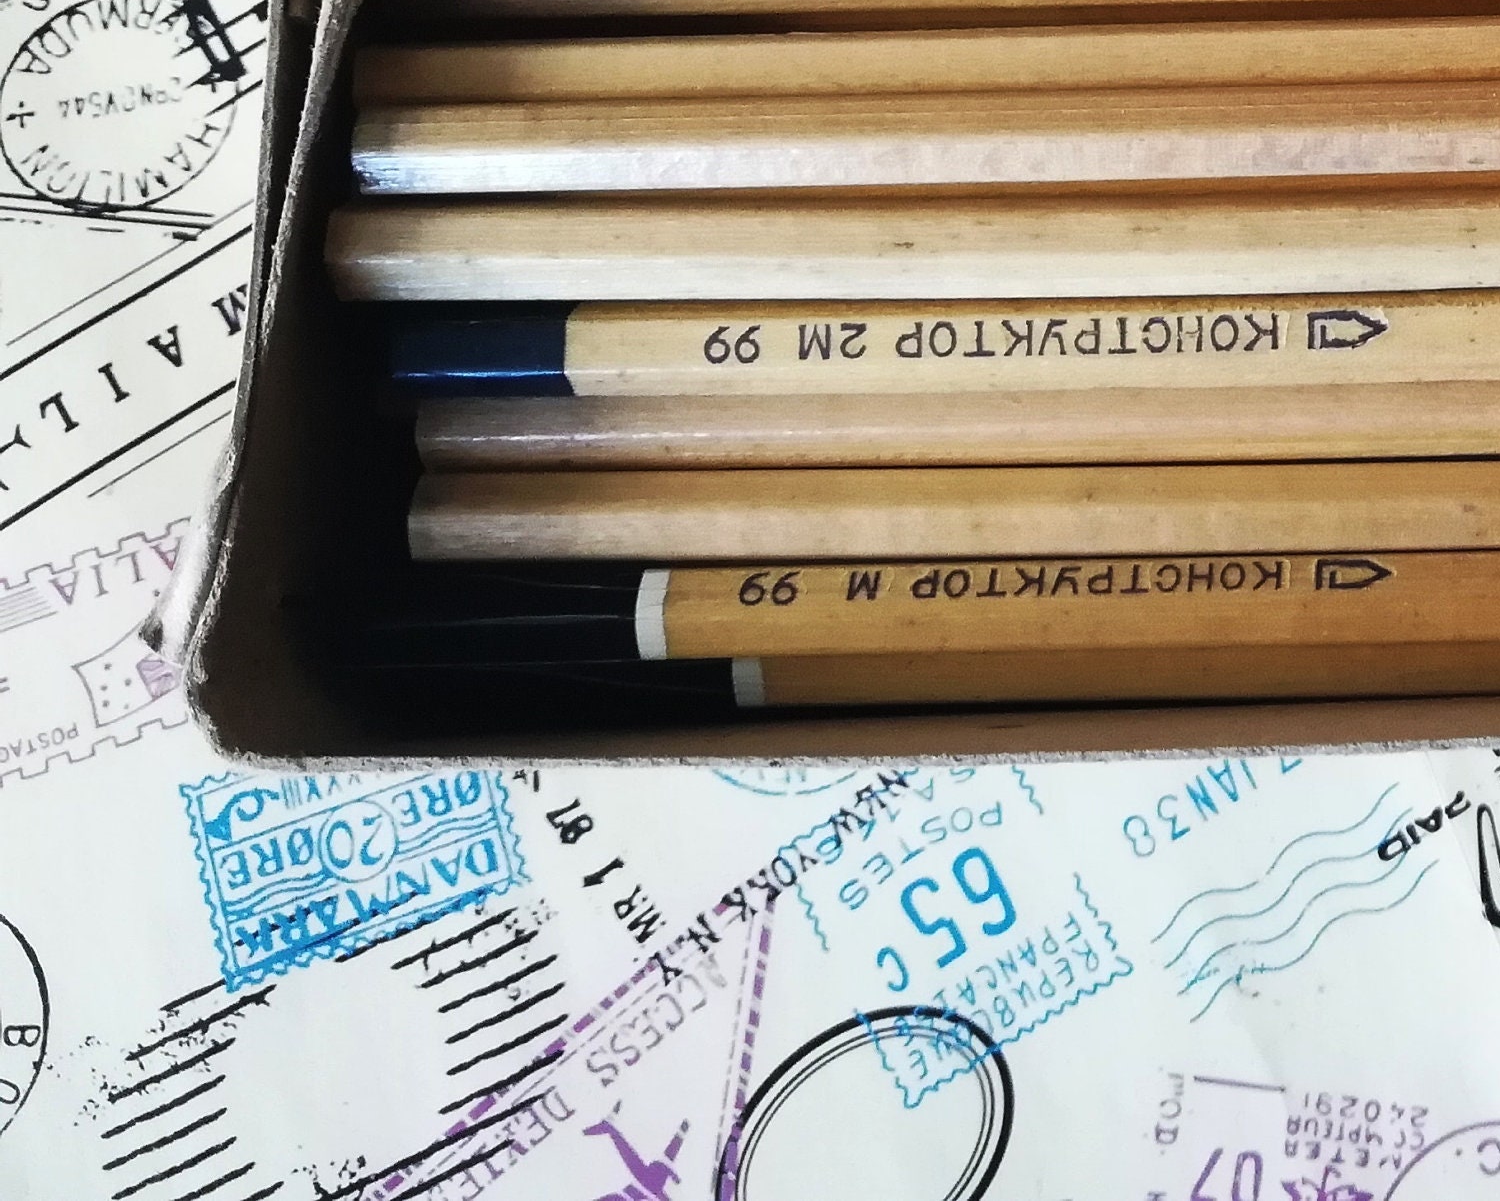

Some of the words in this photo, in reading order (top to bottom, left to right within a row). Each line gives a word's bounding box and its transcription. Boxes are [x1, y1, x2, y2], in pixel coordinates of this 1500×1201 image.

[703, 324, 762, 365] 99
[896, 313, 1281, 358] КОНСТРУКТОР
[738, 572, 801, 607] 99
[912, 560, 1283, 600] КОНСТРУКТОР
[326, 811, 391, 873] 20
[840, 802, 1004, 911] POSTES
[1377, 790, 1473, 862] PAID
[235, 836, 500, 956] DANMARK
[901, 846, 1018, 969] 65
[587, 949, 727, 1088] ACCESS
